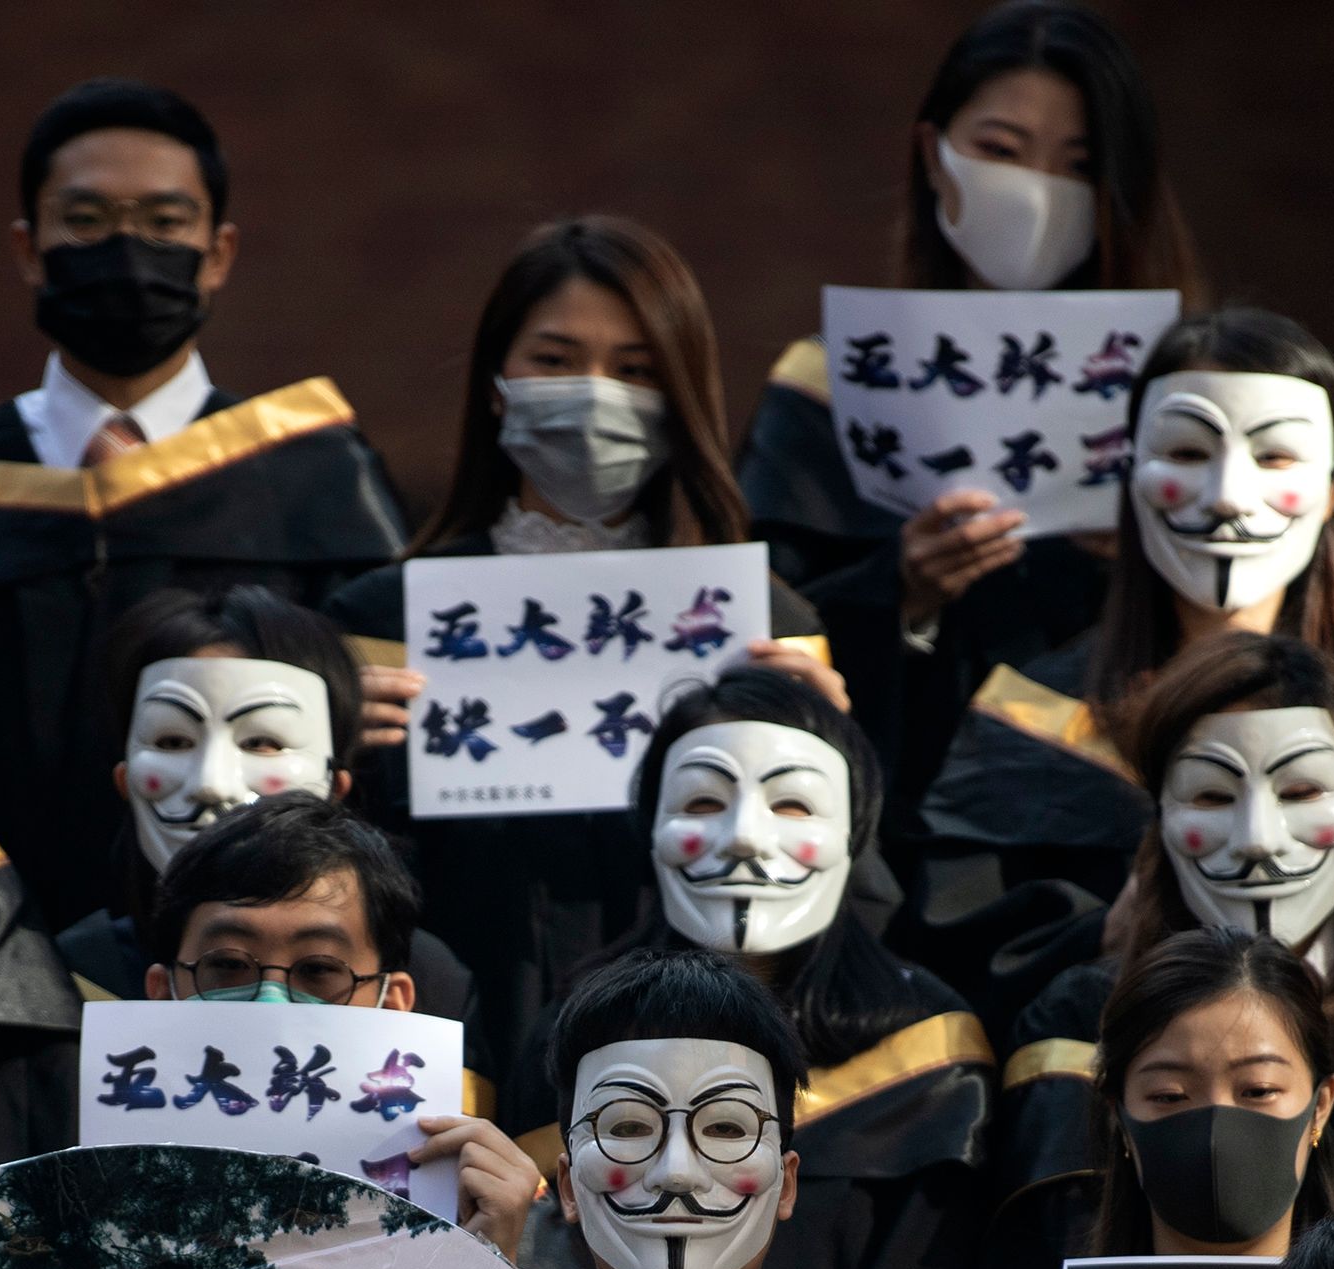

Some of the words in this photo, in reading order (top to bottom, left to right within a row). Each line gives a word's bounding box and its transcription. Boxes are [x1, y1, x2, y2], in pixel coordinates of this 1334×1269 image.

[843, 330, 1141, 400] 五大訴求
[423, 585, 734, 662] 五大訴求
[420, 691, 657, 762] 缺一不
[97, 1043, 426, 1122] 五大訴求
